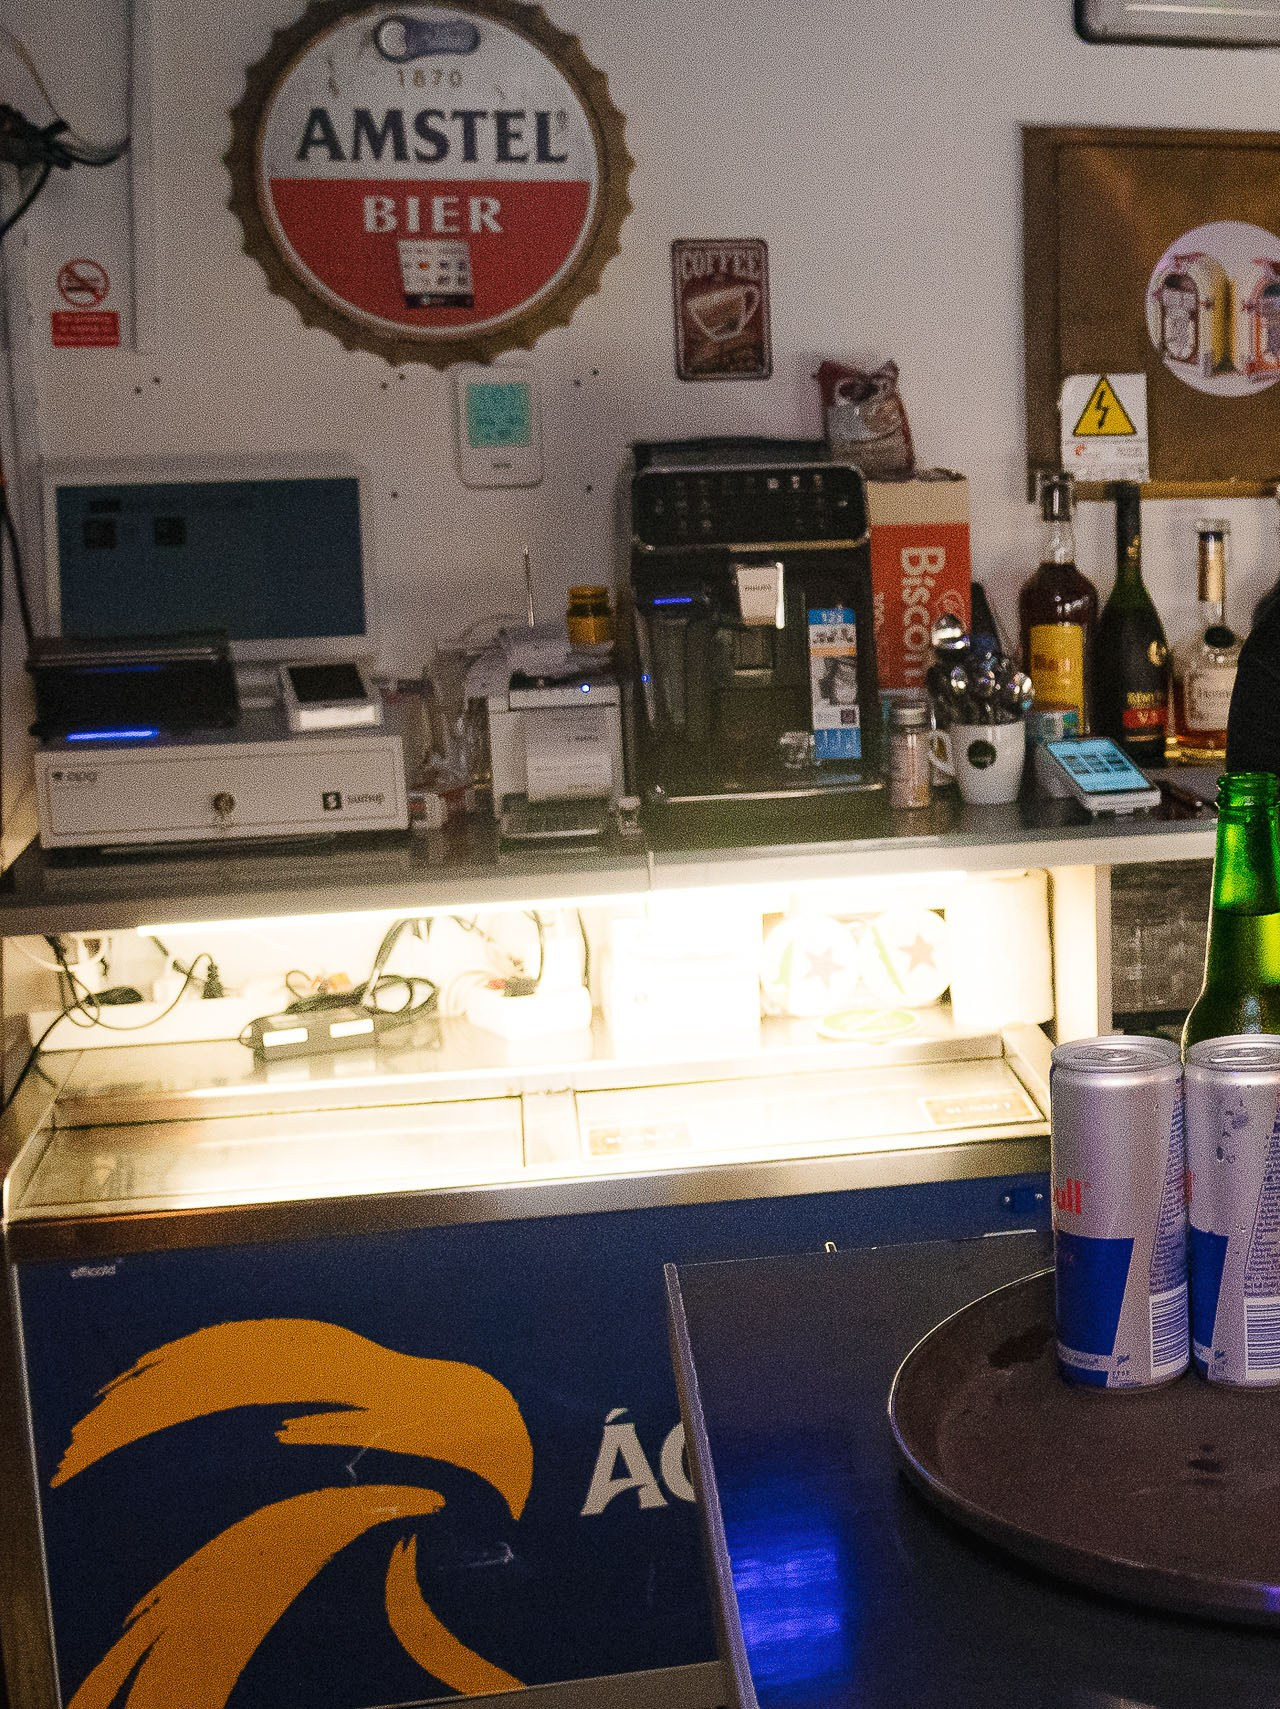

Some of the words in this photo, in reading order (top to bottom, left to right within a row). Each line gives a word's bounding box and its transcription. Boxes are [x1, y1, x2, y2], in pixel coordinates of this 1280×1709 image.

[397, 69, 462, 88] 1870
[363, 195, 503, 234] BIER
[681, 249, 761, 281] COFFEE
[901, 546, 946, 680] Bisco
